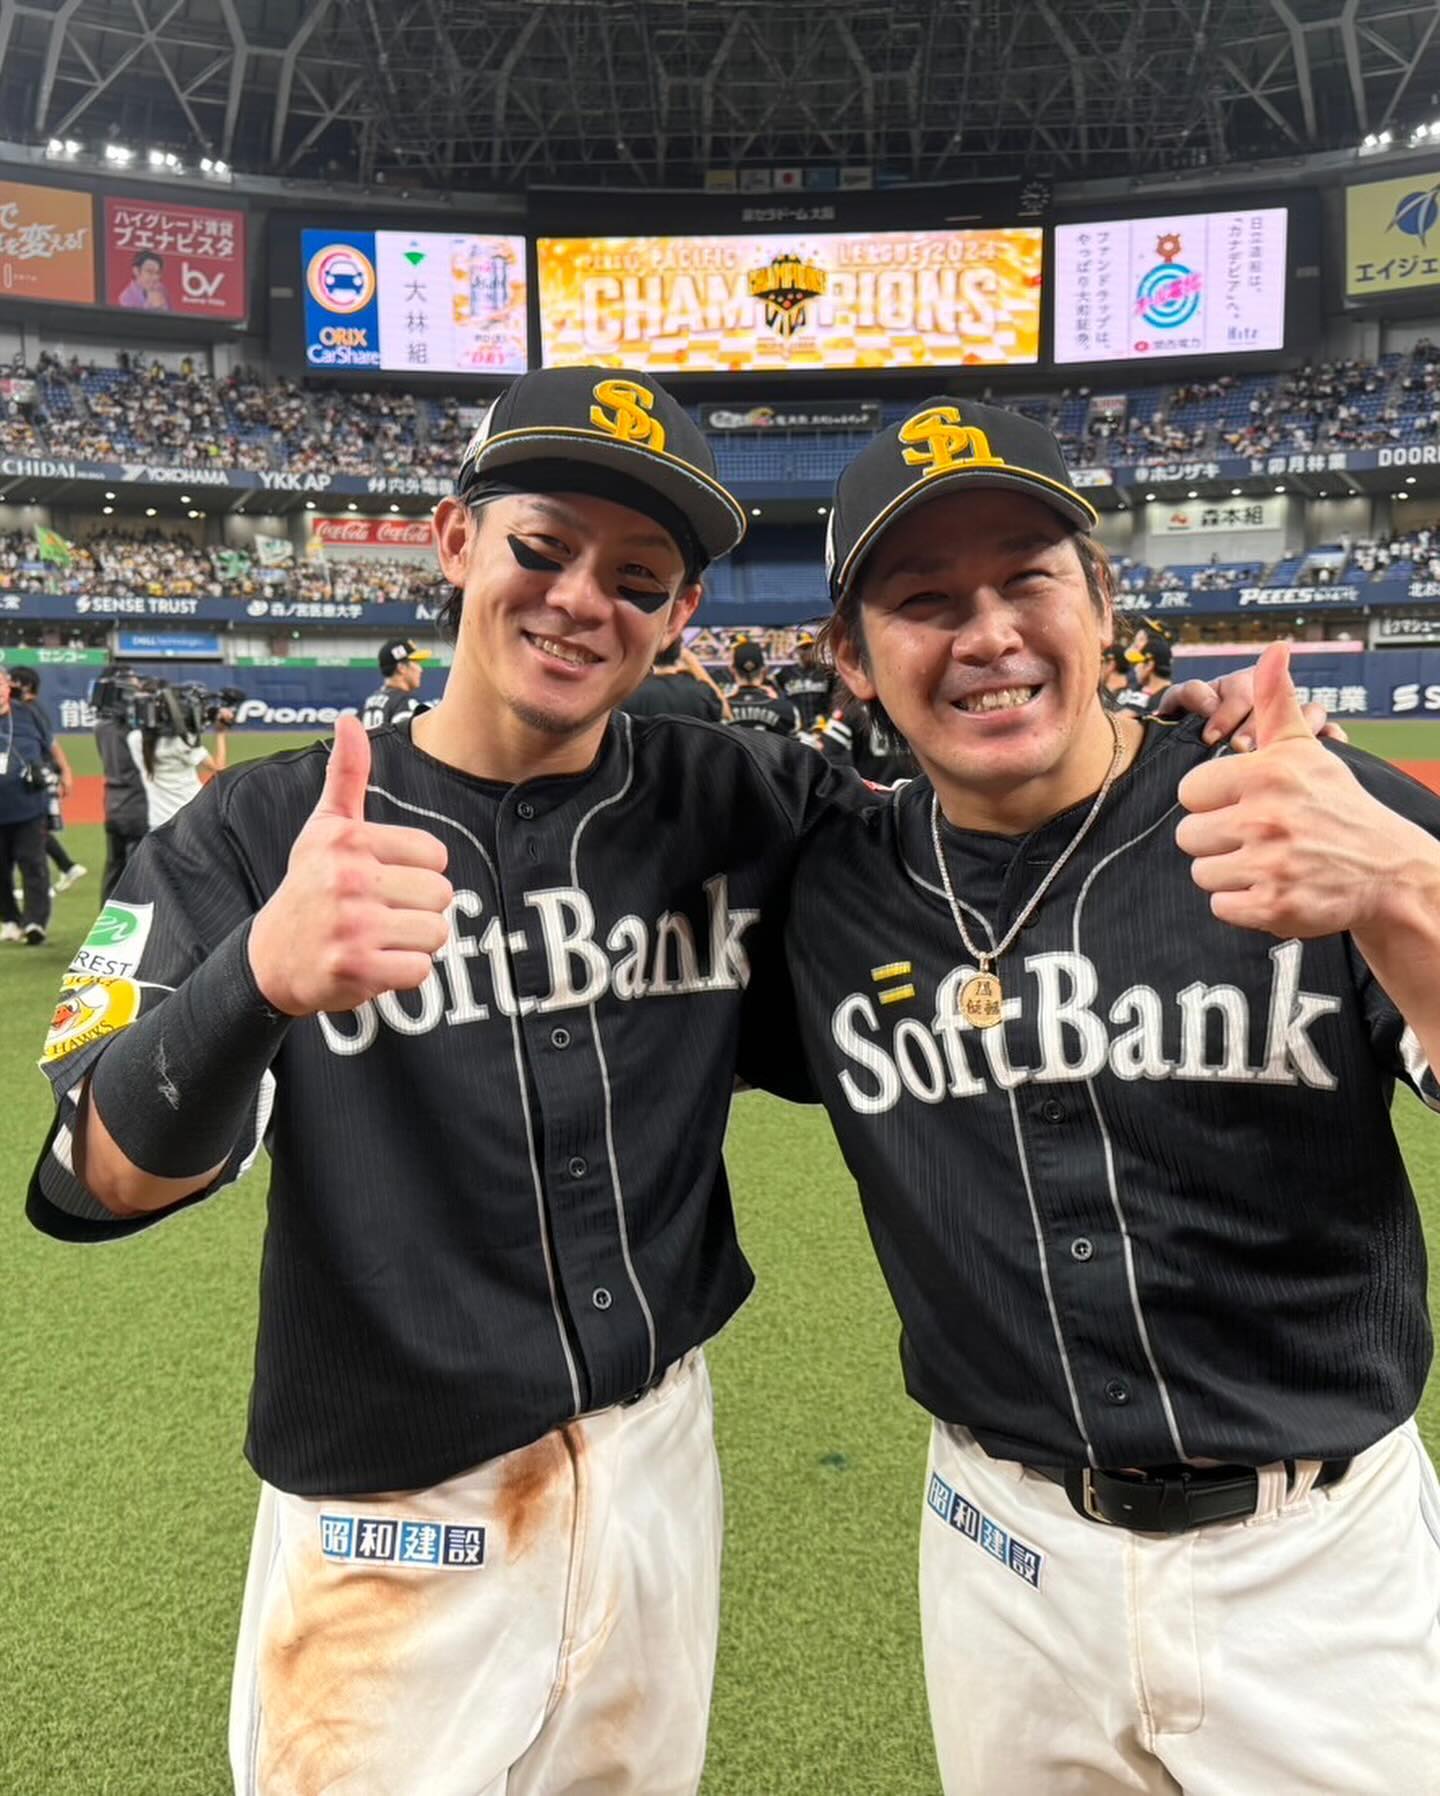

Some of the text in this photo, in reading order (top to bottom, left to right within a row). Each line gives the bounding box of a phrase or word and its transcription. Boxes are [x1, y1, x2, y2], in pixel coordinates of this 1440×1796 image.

[114, 210, 234, 238] ハイグレード賃貸
[112, 226, 235, 257] ブエナビスタ
[403, 281, 428, 365] 大林組
[318, 326, 368, 348] ORIX
[307, 345, 380, 366] CarShare
[1377, 445, 1440, 467] DOOR
[147, 467, 229, 485] YOKOHAMA
[258, 471, 332, 491] YKK AP
[1202, 508, 1264, 526] 森本組
[91, 596, 199, 615] SENSE TRUST
[38, 650, 88, 663] センコー
[51, 1018, 115, 1056] HAWKS
[831, 937, 1343, 1115] SoftBank
[321, 1518, 482, 1564] 昭和建設
[928, 1479, 1038, 1583] 昭和建設
